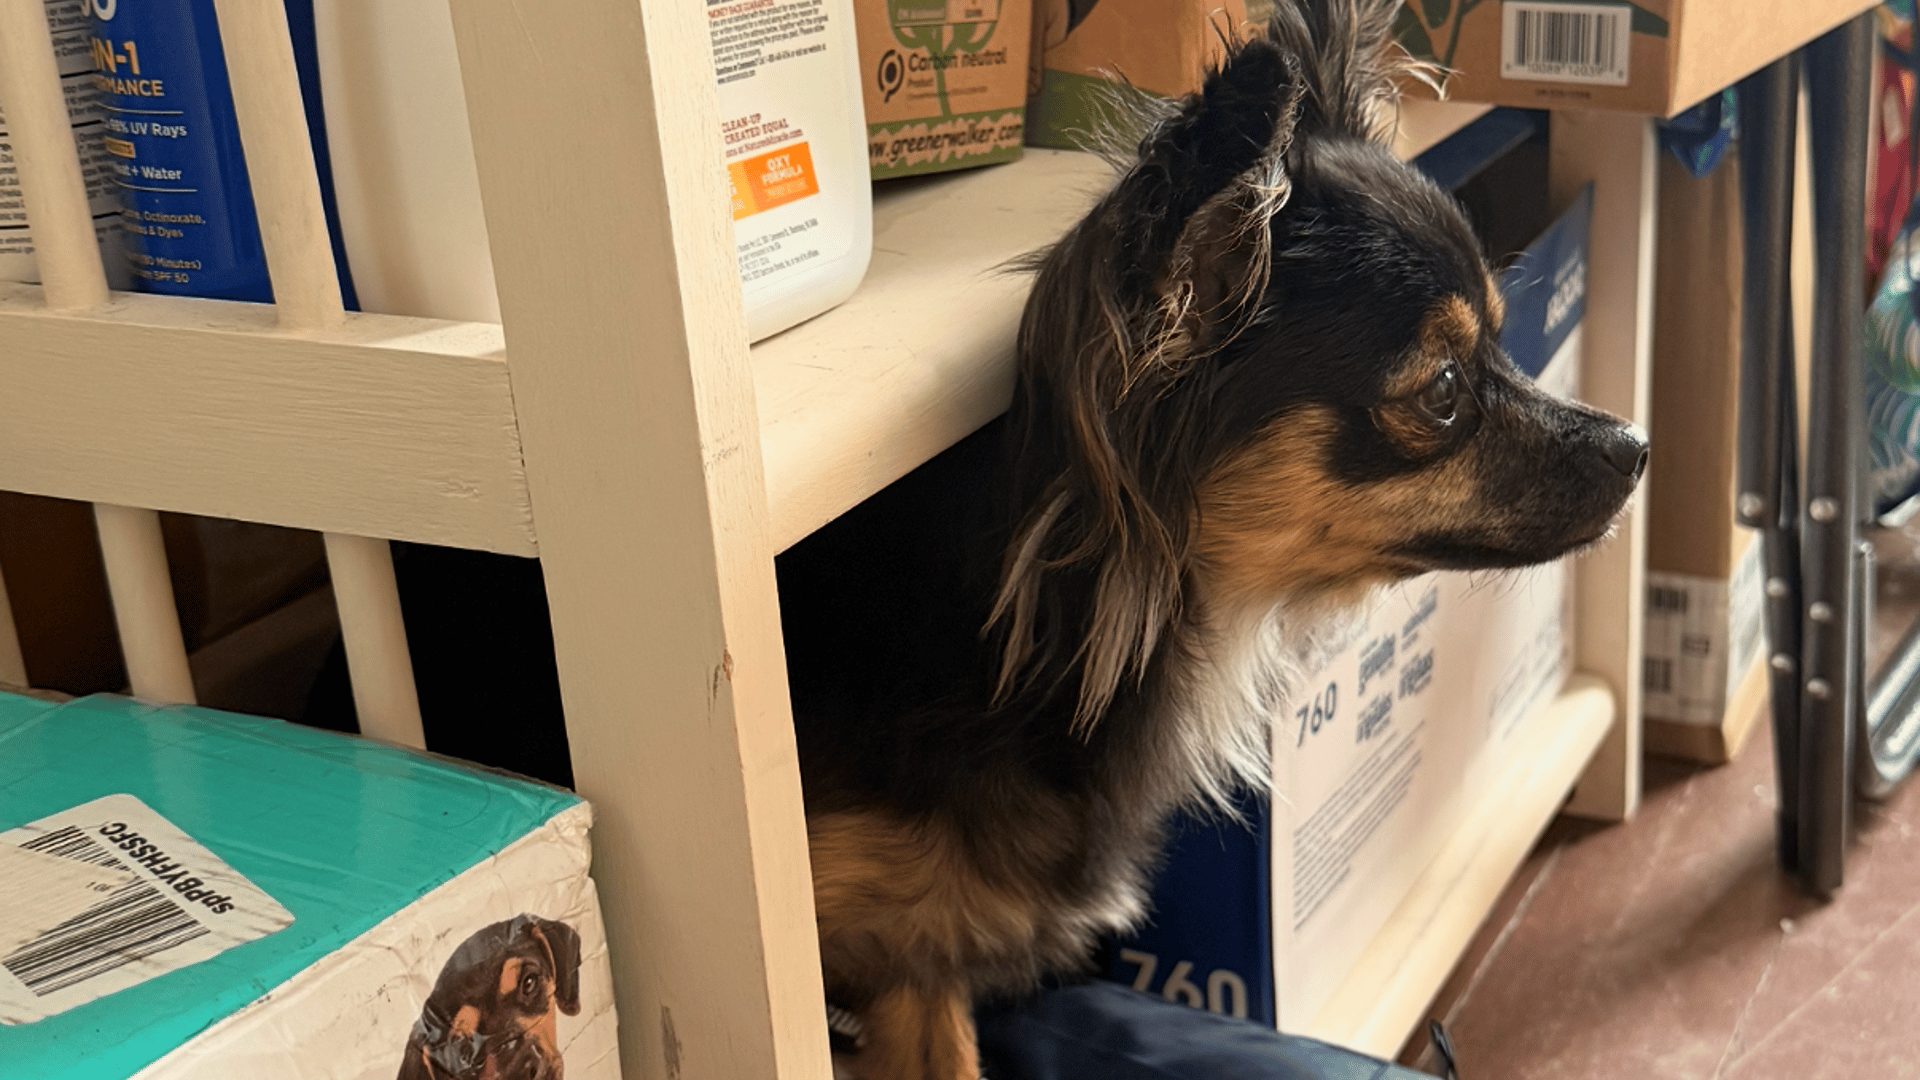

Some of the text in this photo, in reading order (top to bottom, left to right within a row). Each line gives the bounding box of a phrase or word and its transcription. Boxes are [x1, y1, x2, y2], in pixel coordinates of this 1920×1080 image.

[908, 47, 1007, 72] Carbon neutral
[130, 122, 148, 135] UV
[151, 123, 188, 139] Rays
[141, 166, 182, 181] Water
[766, 154, 790, 172] OXY
[1295, 681, 1337, 748] 760
[1118, 947, 1247, 1020] 760
